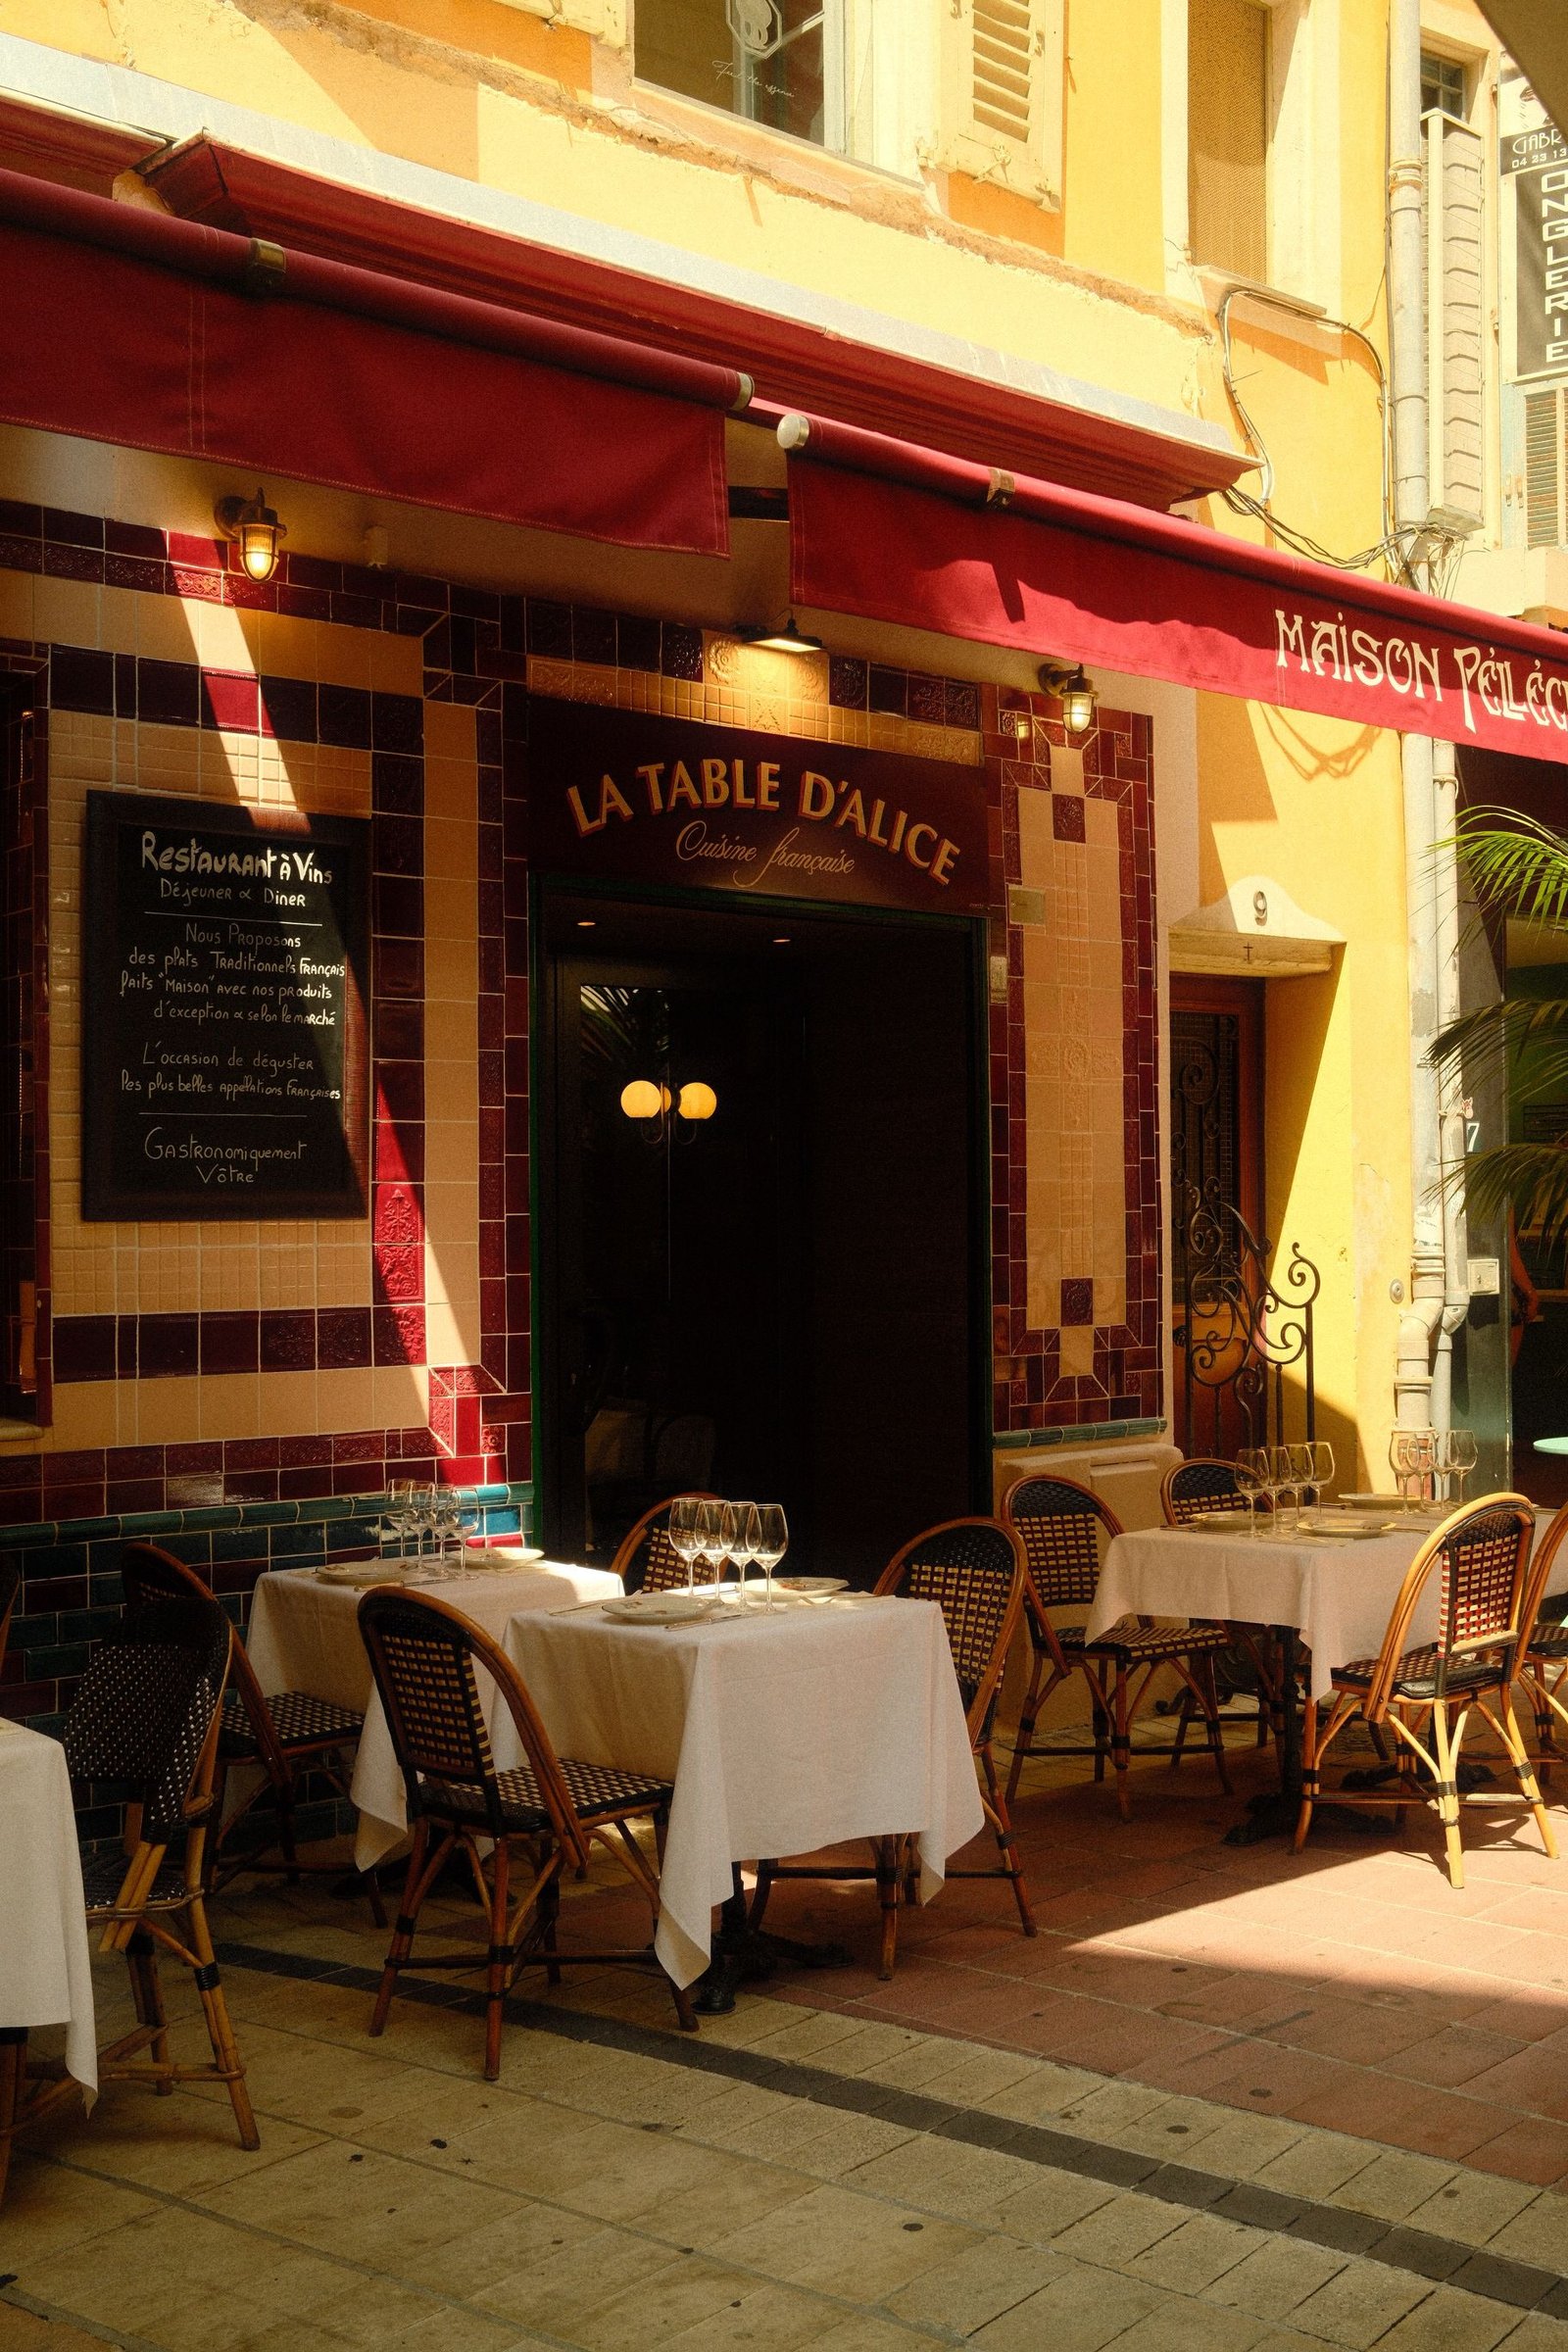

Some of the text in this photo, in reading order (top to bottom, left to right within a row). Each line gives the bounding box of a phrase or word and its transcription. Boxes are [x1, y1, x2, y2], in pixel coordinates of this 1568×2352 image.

[1512, 158, 1527, 169] 04
[1532, 153, 1547, 164] 23
[1542, 170, 1568, 363] ONGLERIE
[566, 759, 961, 886] LA TABLE D'ALICE
[292, 849, 333, 884] Vins
[676, 820, 856, 887] Cuisine française
[1251, 890, 1268, 925] 9
[185, 922, 221, 944] Nous
[129, 946, 156, 964] des
[217, 985, 246, 997] avec
[253, 985, 274, 997] nos
[278, 983, 332, 1005] produits
[247, 1004, 277, 1022] selon
[142, 1041, 314, 1078] L'occasion de déguster
[122, 1069, 142, 1092] les
[148, 1070, 173, 1099] plus
[177, 1074, 214, 1094] belles
[144, 1126, 308, 1172] Gastronomiquement
[1466, 1122, 1480, 1152] 7
